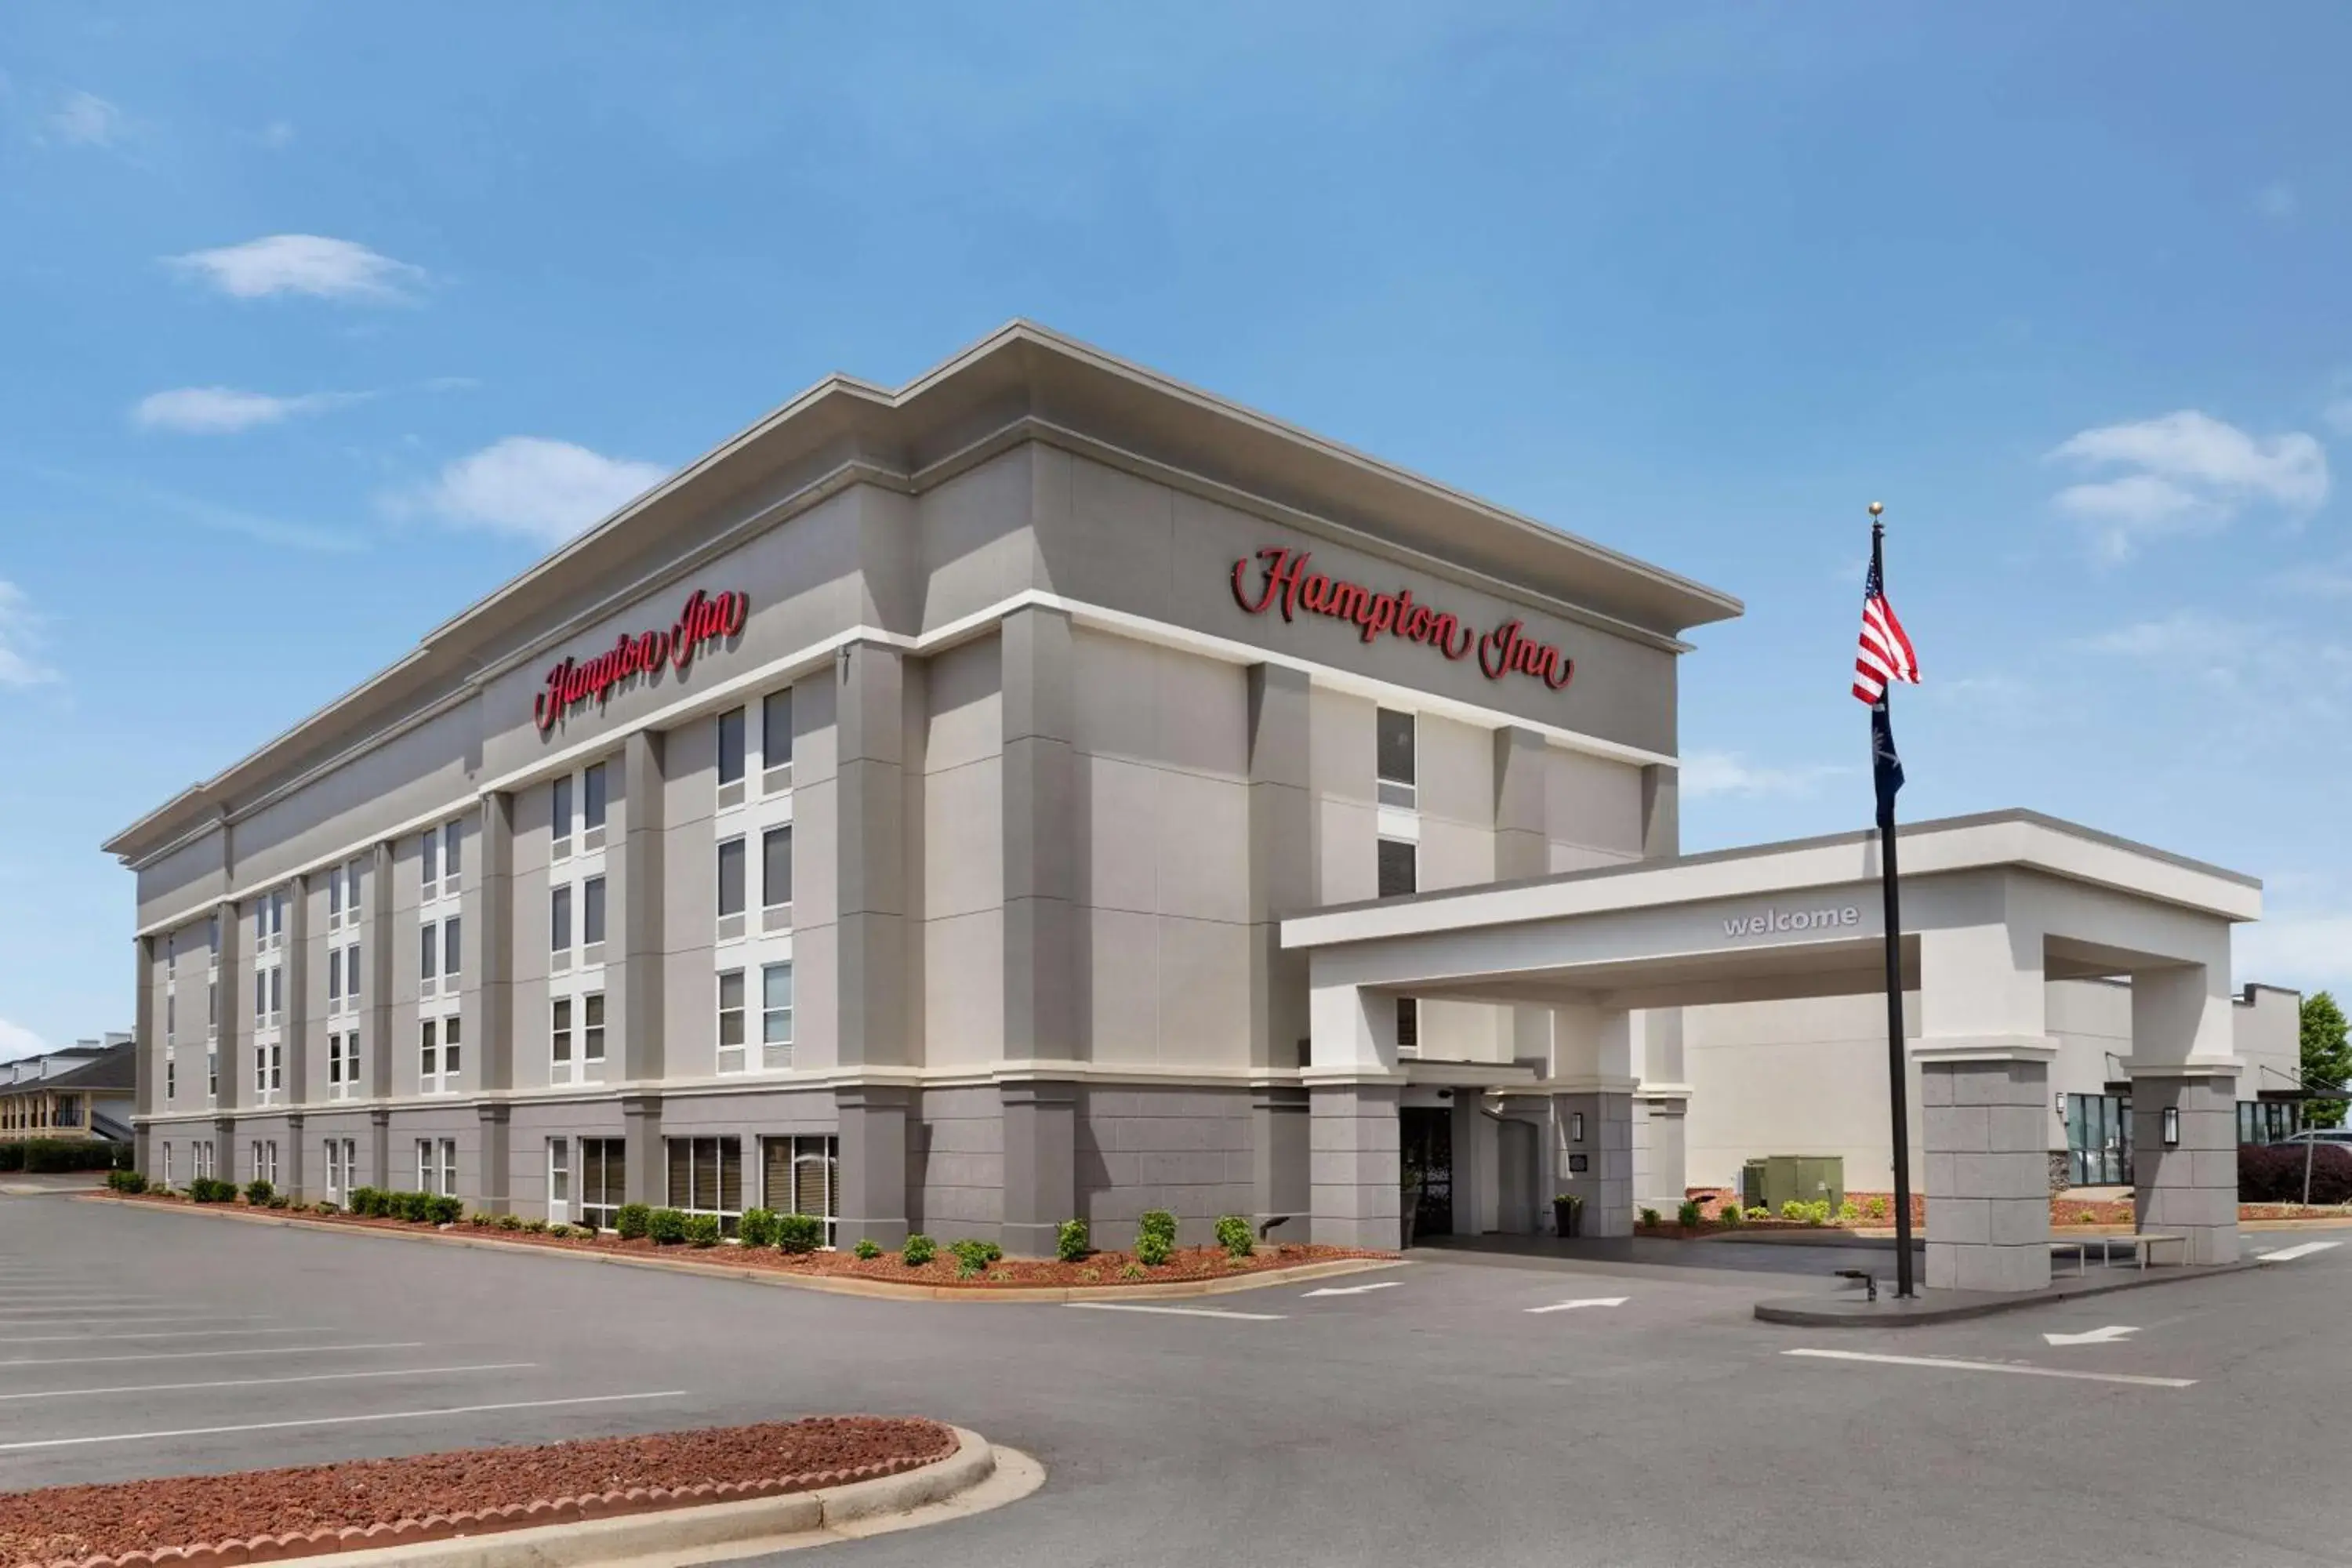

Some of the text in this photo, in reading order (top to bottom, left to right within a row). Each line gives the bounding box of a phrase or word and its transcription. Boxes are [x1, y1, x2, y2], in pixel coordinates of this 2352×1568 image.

[534, 590, 744, 730] Hampton Inn
[1231, 547, 1573, 690] Hampton Inn
[1724, 906, 1858, 936] welcome
